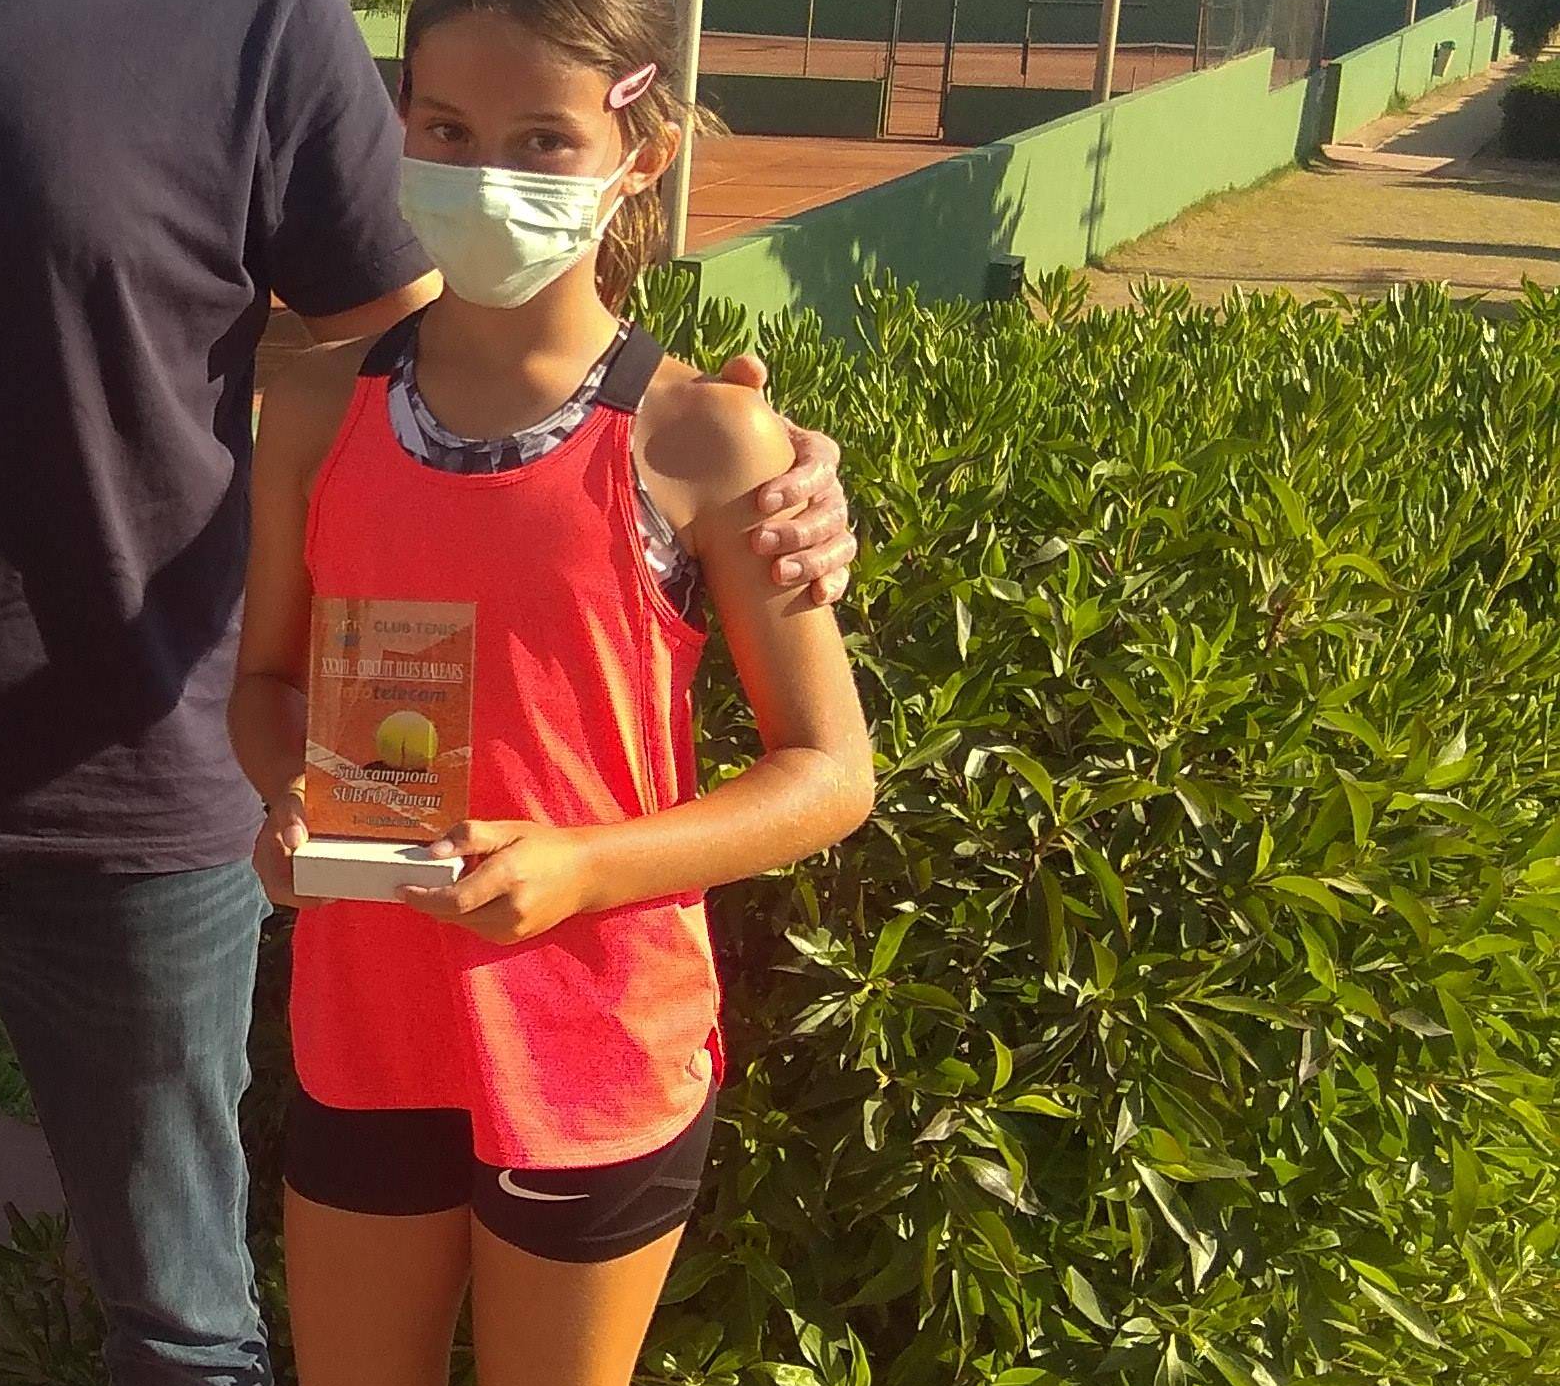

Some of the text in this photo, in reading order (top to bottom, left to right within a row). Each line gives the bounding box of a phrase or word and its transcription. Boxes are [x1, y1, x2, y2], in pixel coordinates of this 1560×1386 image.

[374, 620, 459, 636] CLUB TENIS
[396, 660, 420, 679] ILLES
[422, 661, 464, 680] BALEARS
[335, 764, 440, 786] Subcampiona
